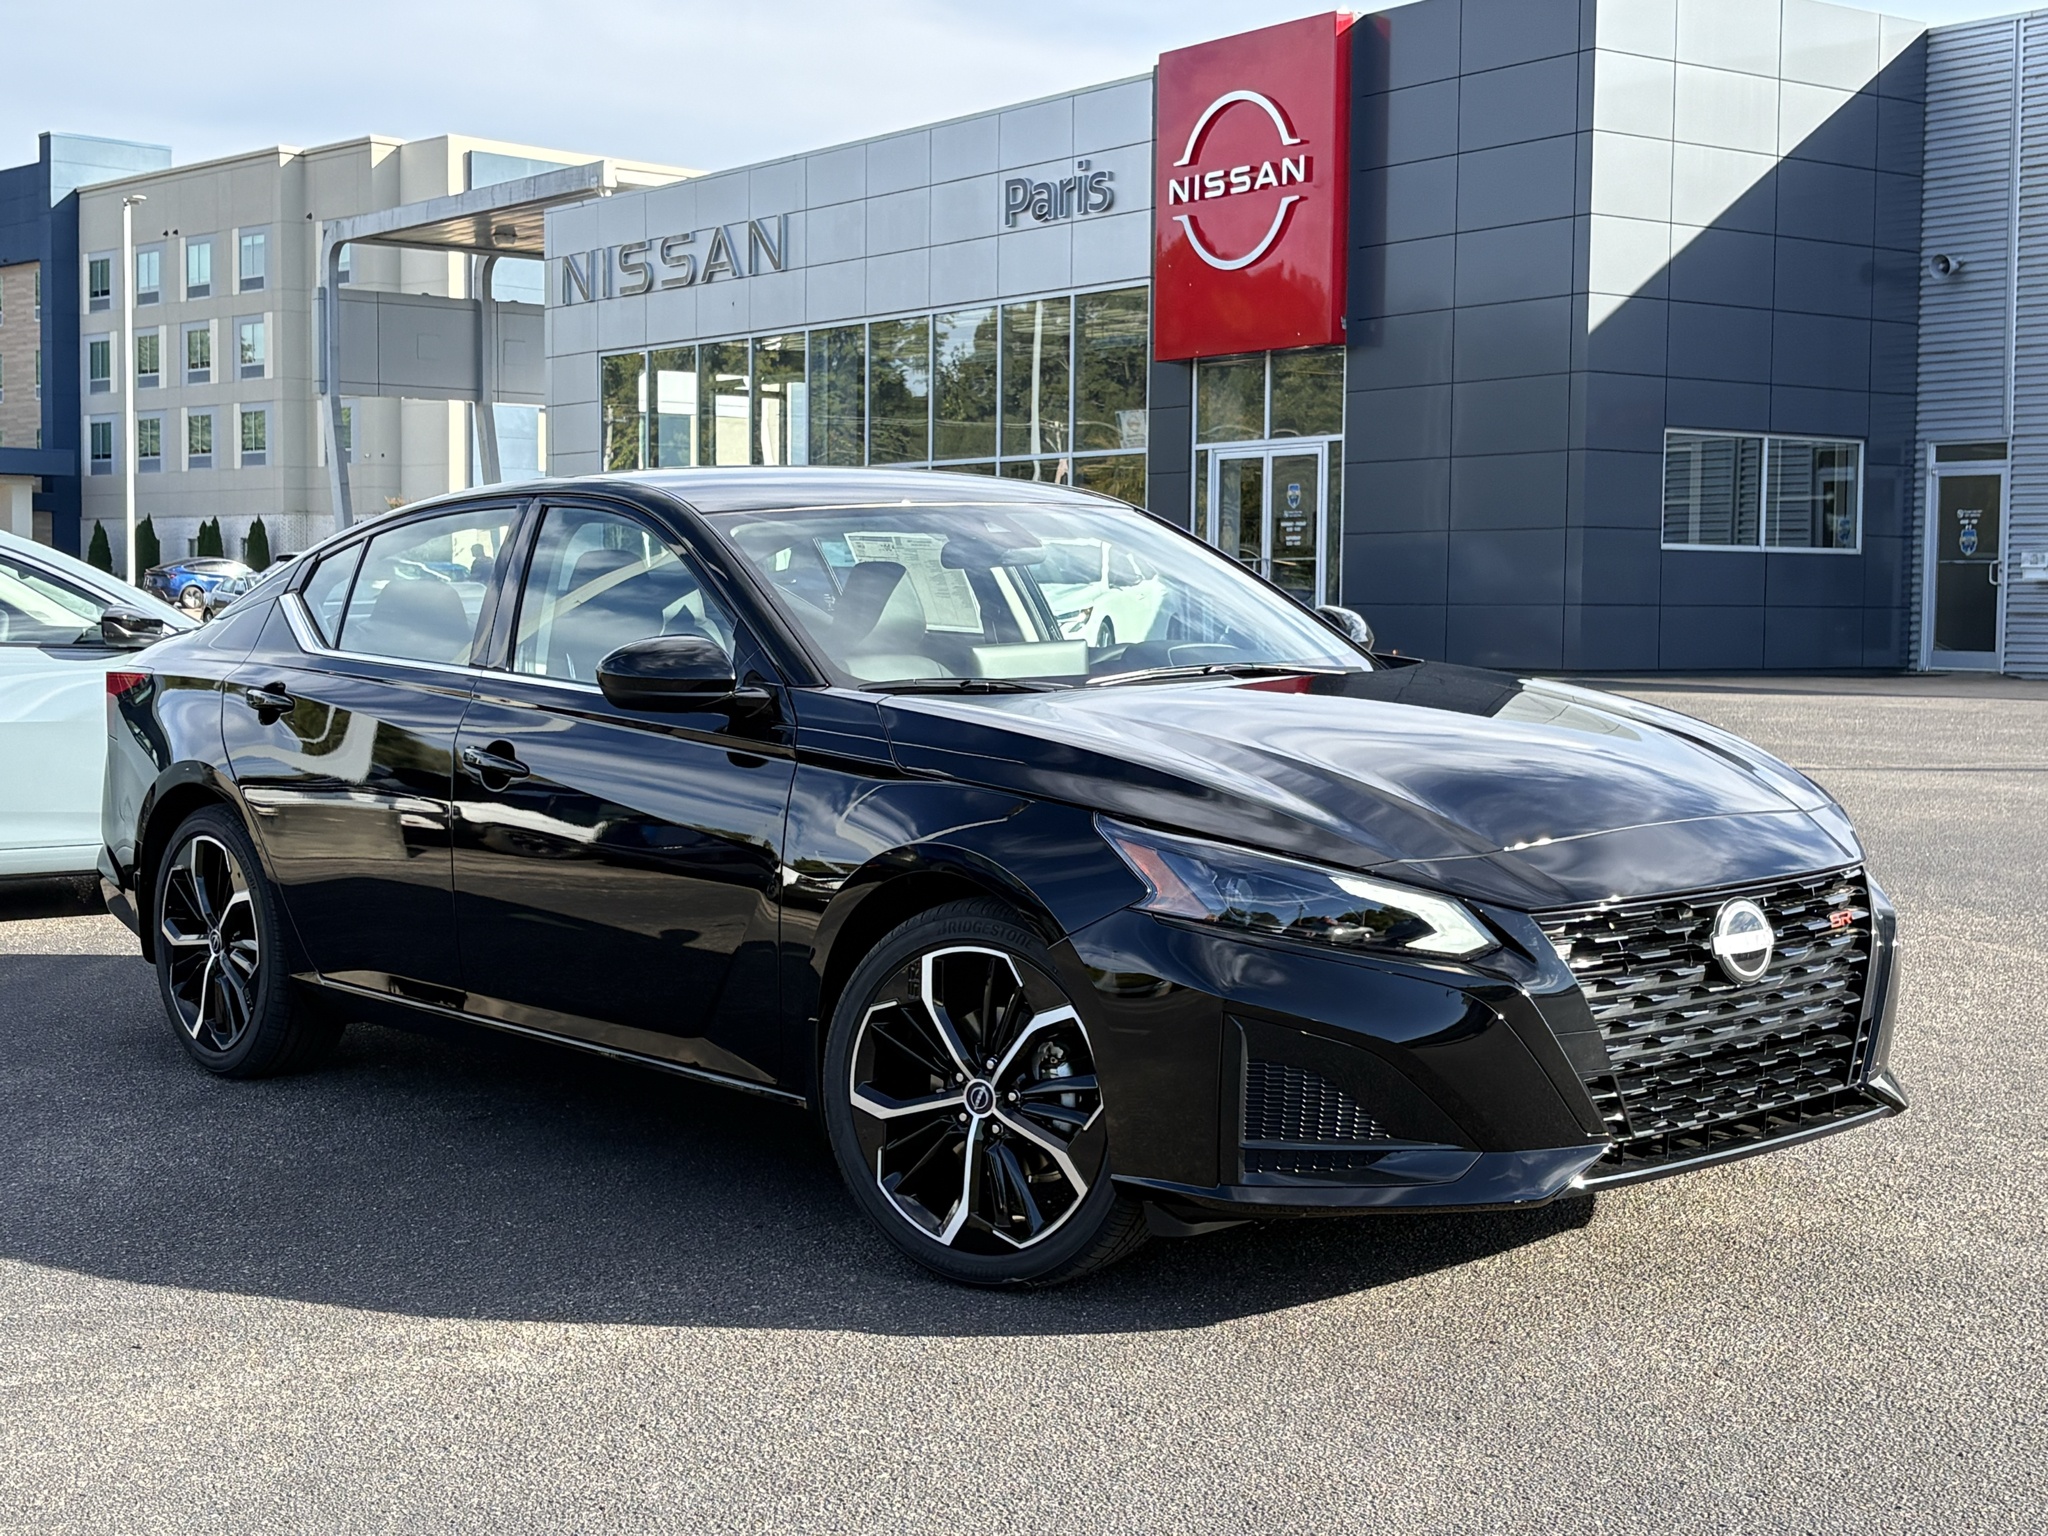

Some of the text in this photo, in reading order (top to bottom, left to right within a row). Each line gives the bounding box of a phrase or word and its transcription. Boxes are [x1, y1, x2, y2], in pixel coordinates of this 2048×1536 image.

[1004, 159, 1114, 228] Paris
[1168, 154, 1306, 206] NISSAN
[561, 213, 788, 306] NISSAN
[937, 920, 1034, 950] BRIDGESTONE
[1829, 910, 1852, 929] SR
